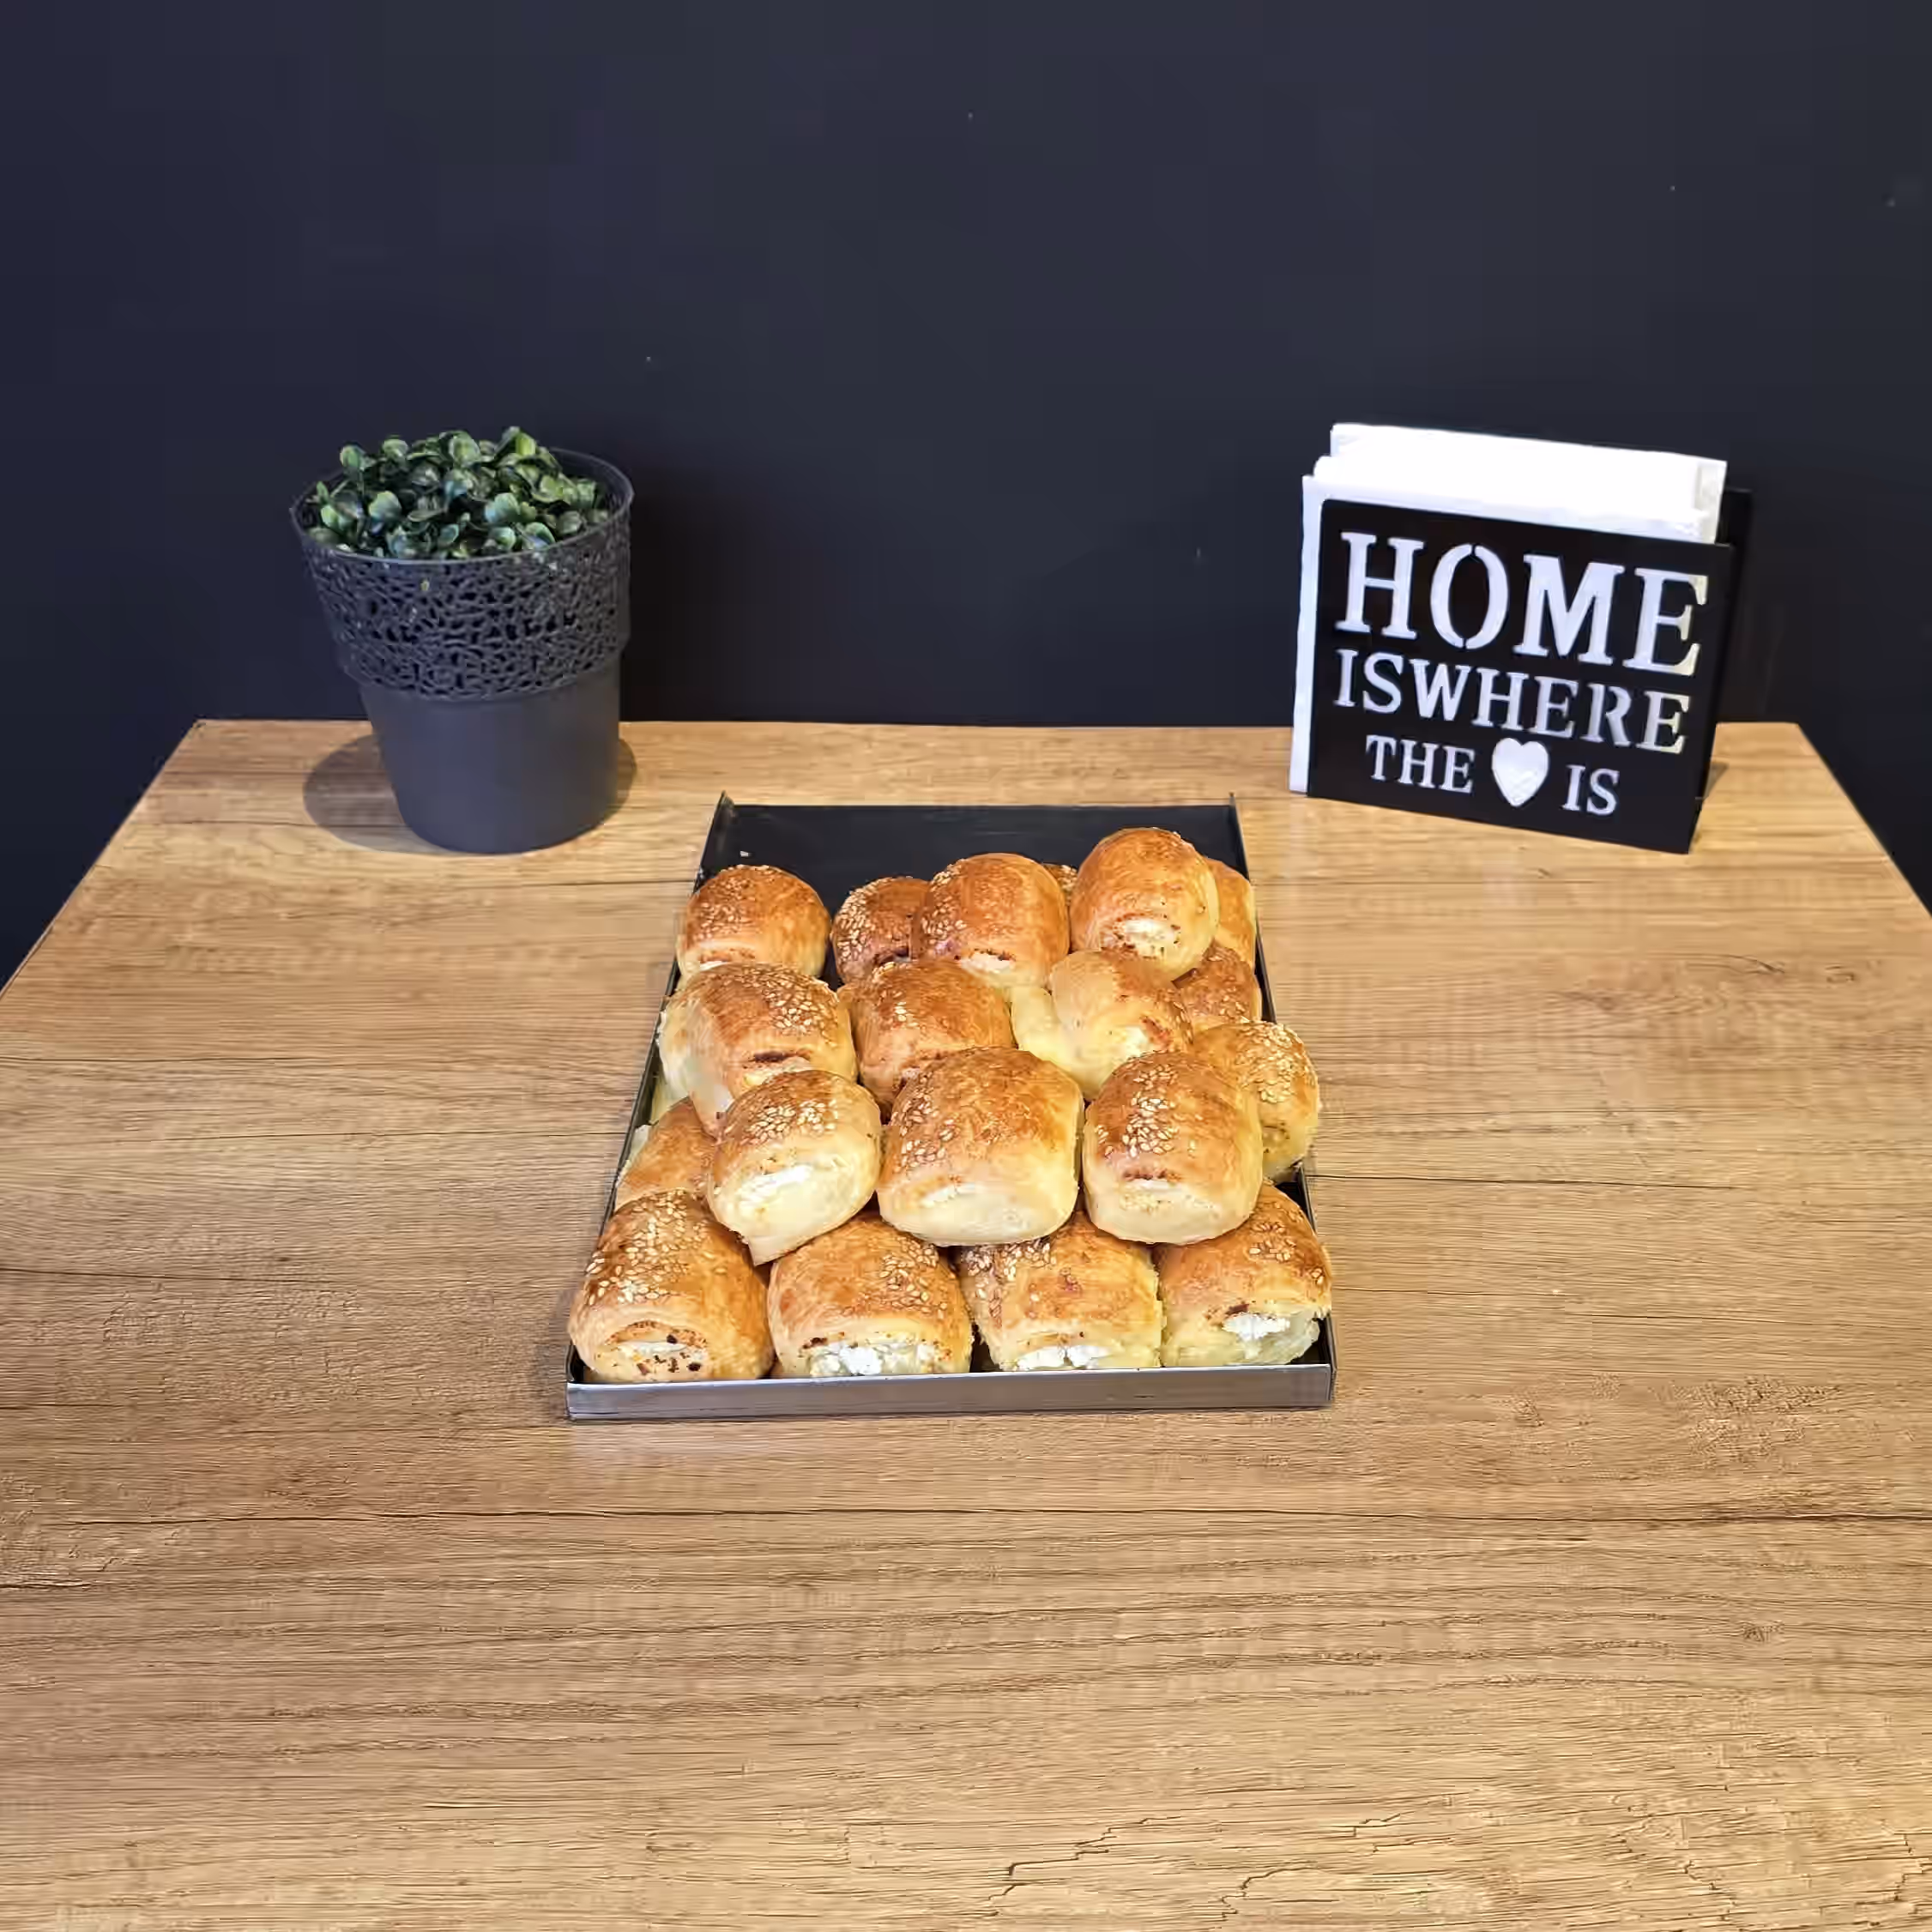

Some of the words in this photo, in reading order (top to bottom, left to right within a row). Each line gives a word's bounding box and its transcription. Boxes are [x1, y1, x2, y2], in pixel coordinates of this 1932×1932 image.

[1335, 531, 1709, 676] HOME
[1365, 734, 1476, 794] THE
[1561, 764, 1621, 817] IS
